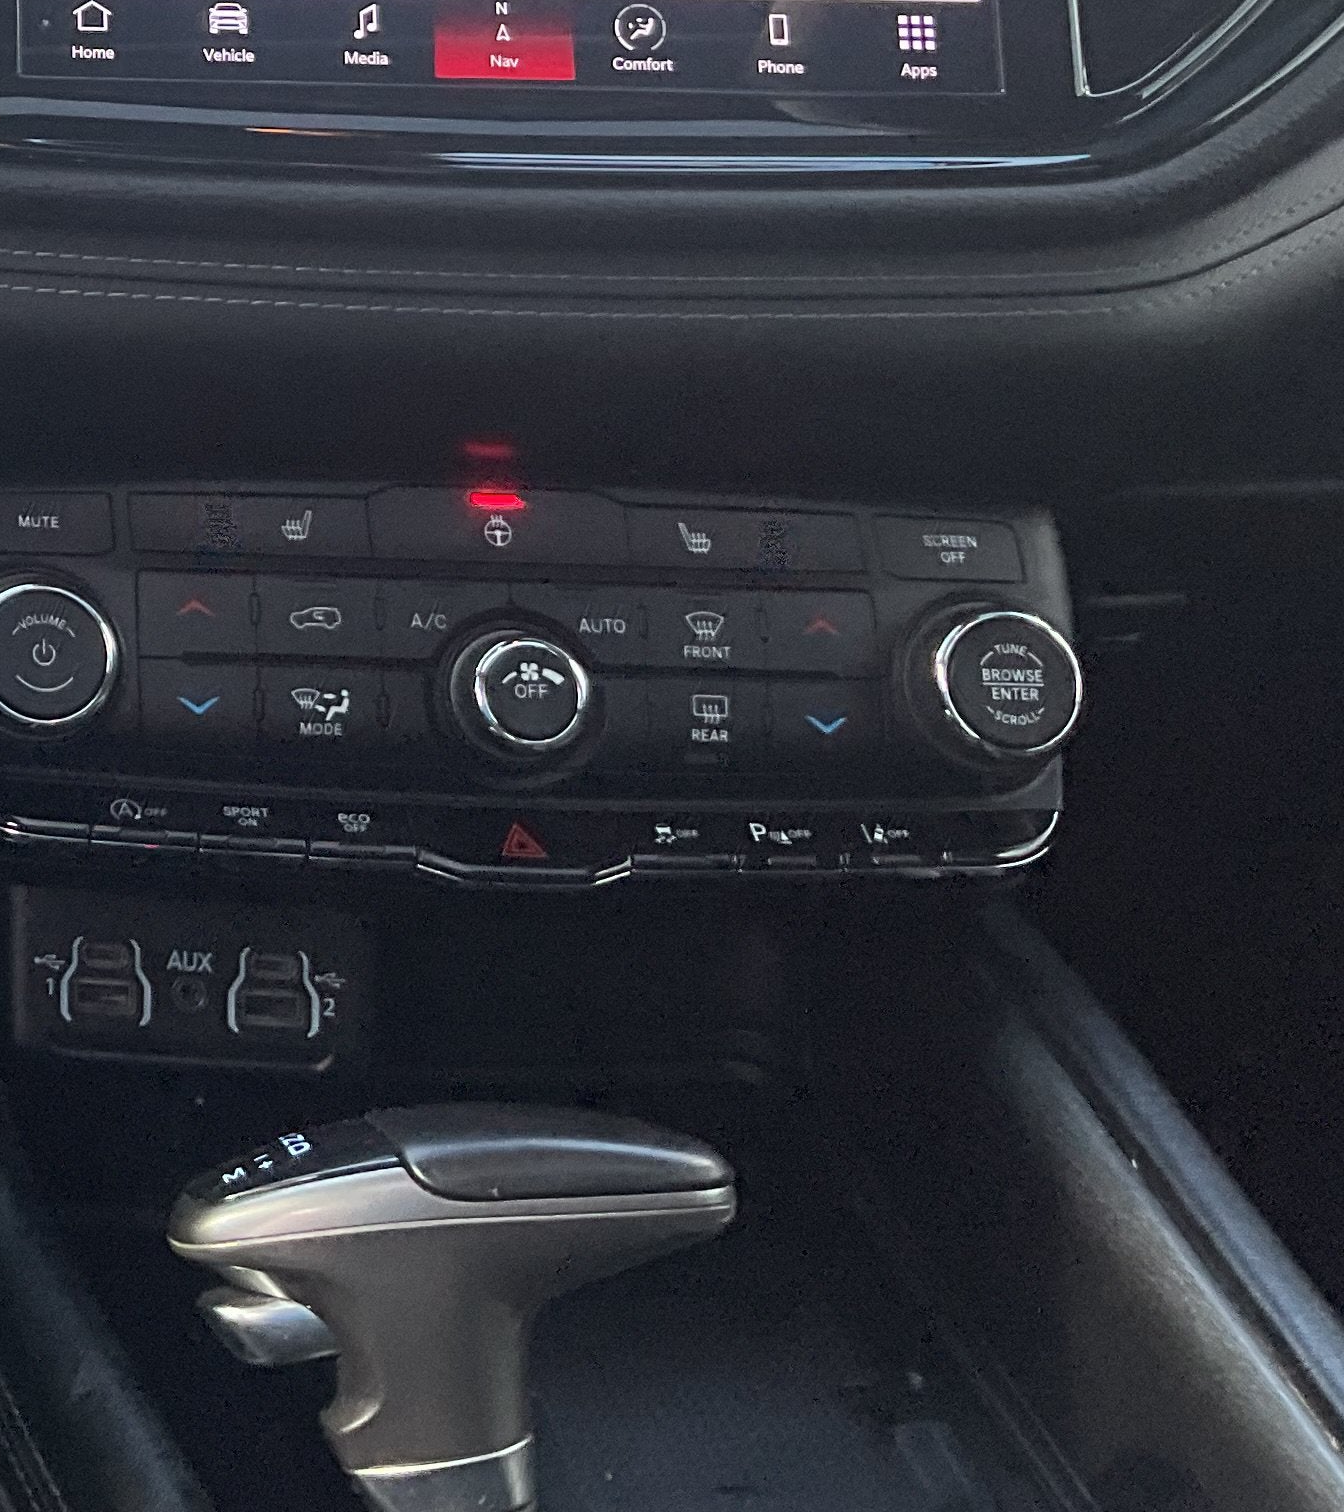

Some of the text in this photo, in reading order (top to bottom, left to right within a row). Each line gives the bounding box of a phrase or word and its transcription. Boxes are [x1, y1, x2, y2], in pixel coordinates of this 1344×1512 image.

[496, 2, 508, 15] N
[71, 45, 115, 60] Home
[203, 48, 255, 63] Vehicle
[344, 51, 389, 66] Media
[490, 54, 519, 68] Nav
[612, 57, 674, 72] Comfort
[758, 60, 804, 76] Phone
[901, 63, 937, 79] Apps
[17, 514, 60, 530] MUTE
[922, 534, 978, 549] SCREEN
[939, 551, 967, 565] OFF
[17, 614, 69, 631] VOLUME
[411, 612, 448, 631] A/C
[578, 617, 627, 634] AUTO
[683, 645, 731, 659] FRONT
[994, 643, 1028, 658] TUNE
[982, 668, 1044, 683] BROWSE
[514, 683, 549, 699] OFF
[991, 687, 1040, 702] ENTER
[994, 710, 1042, 726] SCROLL
[299, 722, 343, 736] MODE
[691, 728, 729, 742] REAR
[223, 806, 269, 818] SPORT
[238, 817, 259, 826] ON
[748, 822, 767, 842] P
[167, 950, 212, 973] AUX
[47, 978, 55, 995] 1
[323, 998, 336, 1017] 2
